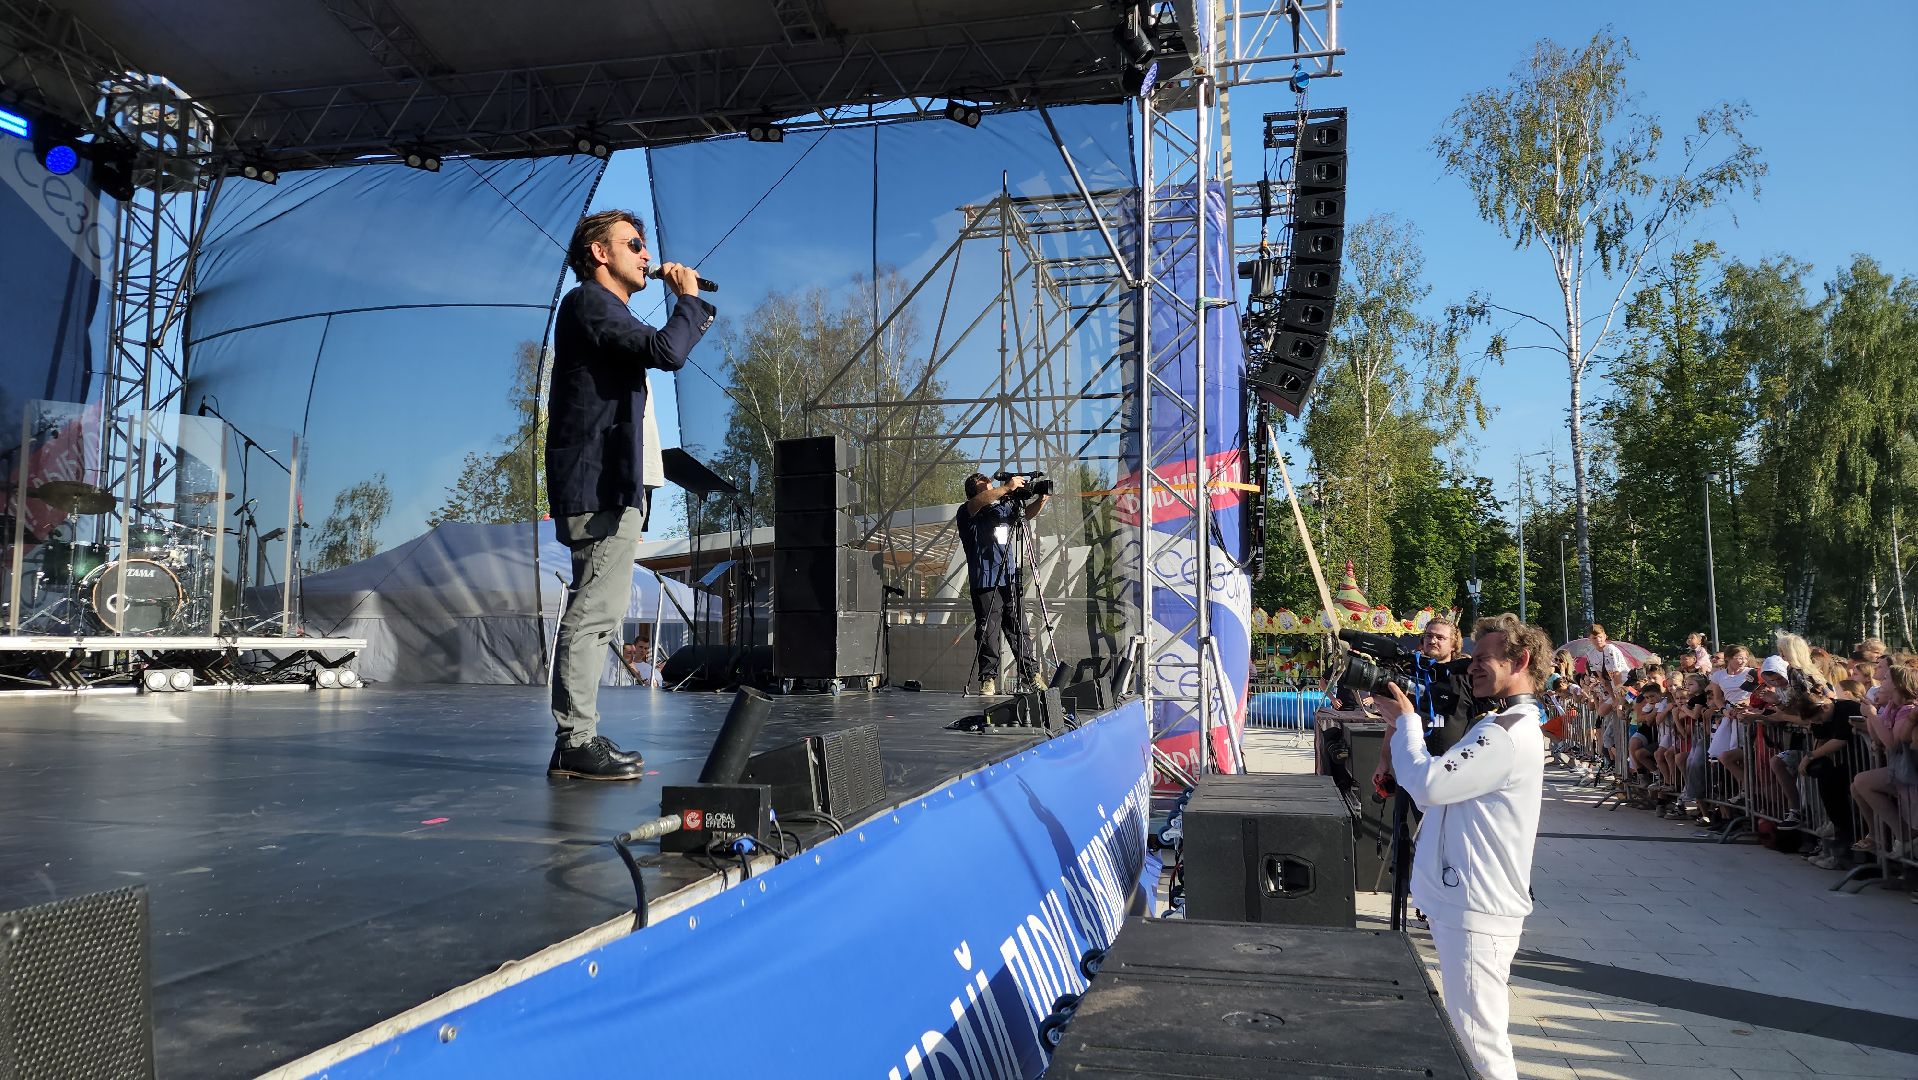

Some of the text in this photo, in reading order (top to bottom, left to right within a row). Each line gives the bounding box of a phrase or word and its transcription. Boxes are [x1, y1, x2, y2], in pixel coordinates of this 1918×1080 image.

[126, 568, 157, 578] TAMA
[705, 812, 735, 822] GLOBAL
[705, 820, 736, 829] EFFECTS
